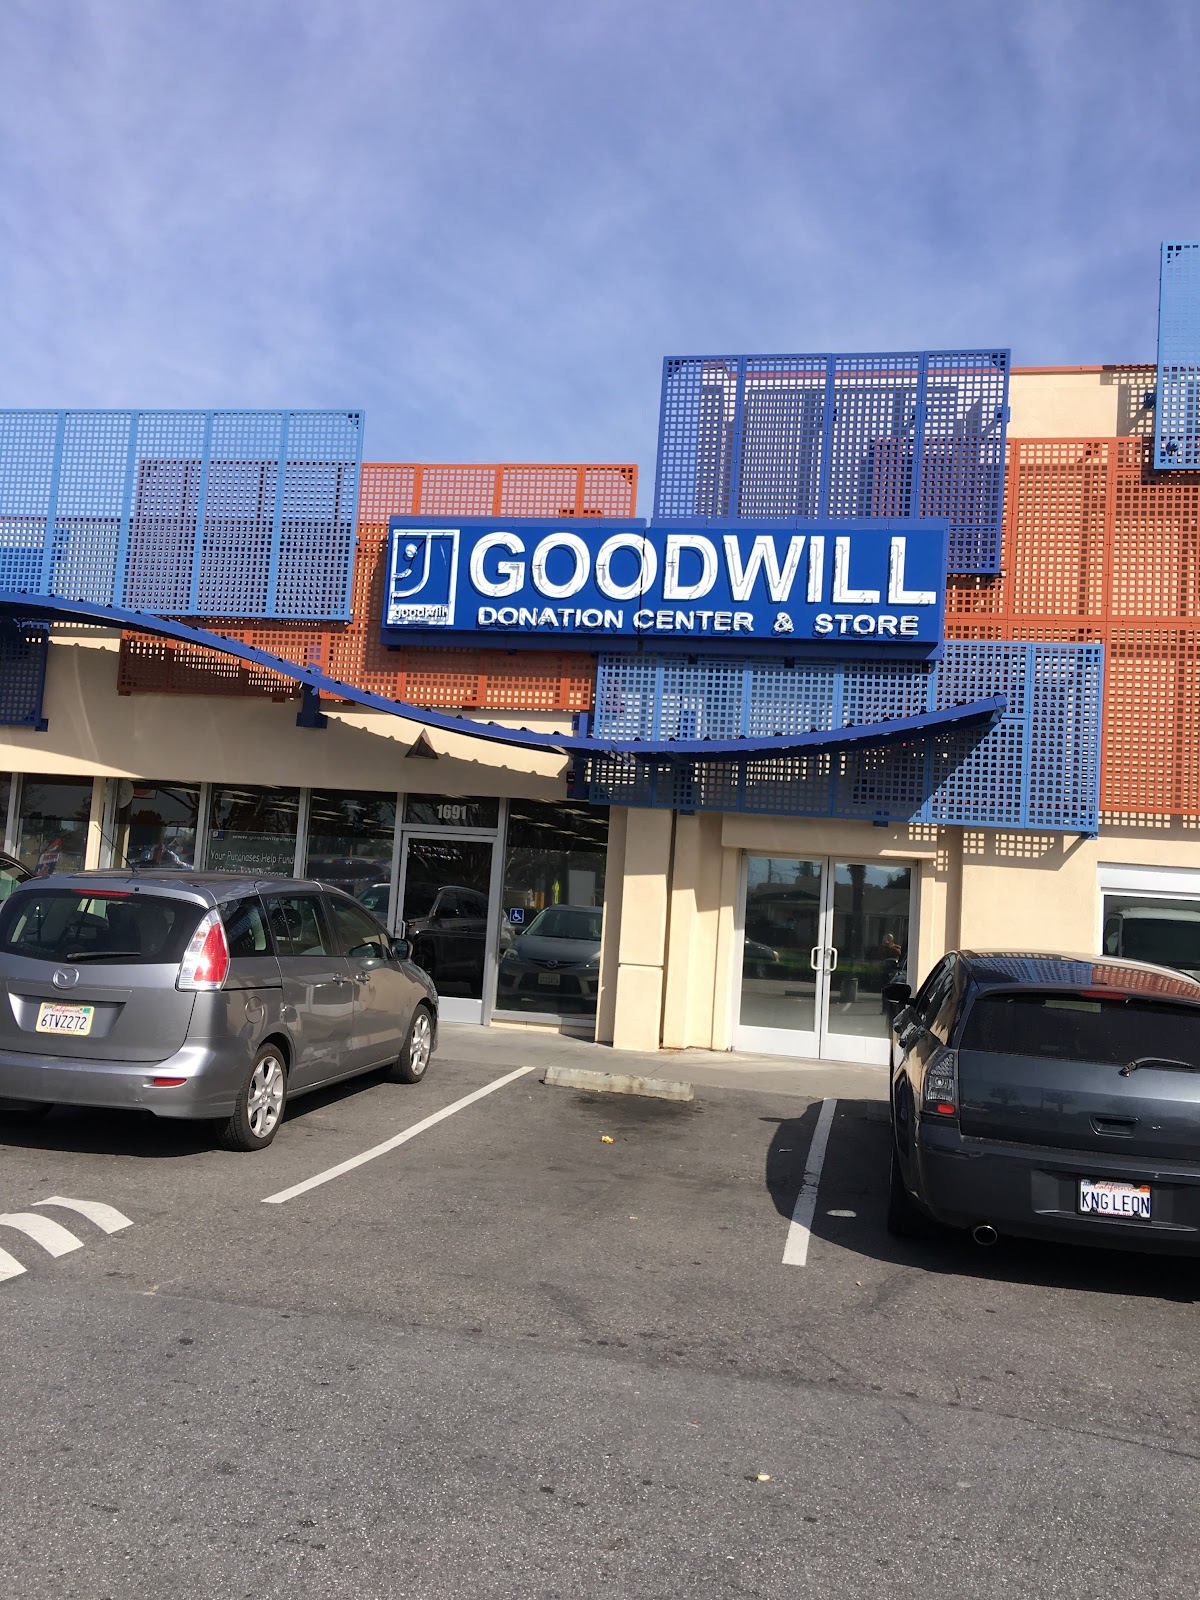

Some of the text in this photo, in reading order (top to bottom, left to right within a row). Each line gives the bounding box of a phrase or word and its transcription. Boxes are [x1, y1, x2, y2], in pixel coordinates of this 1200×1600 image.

[469, 531, 937, 604] GOODWILL
[395, 606, 448, 619] goodwill
[478, 606, 919, 635] DONATION CENTER & STORE
[436, 804, 467, 819] 1691
[210, 850, 294, 866] Your Purchases Help Fund
[41, 1013, 87, 1030] 6TVZ272
[1092, 1183, 1137, 1192] California
